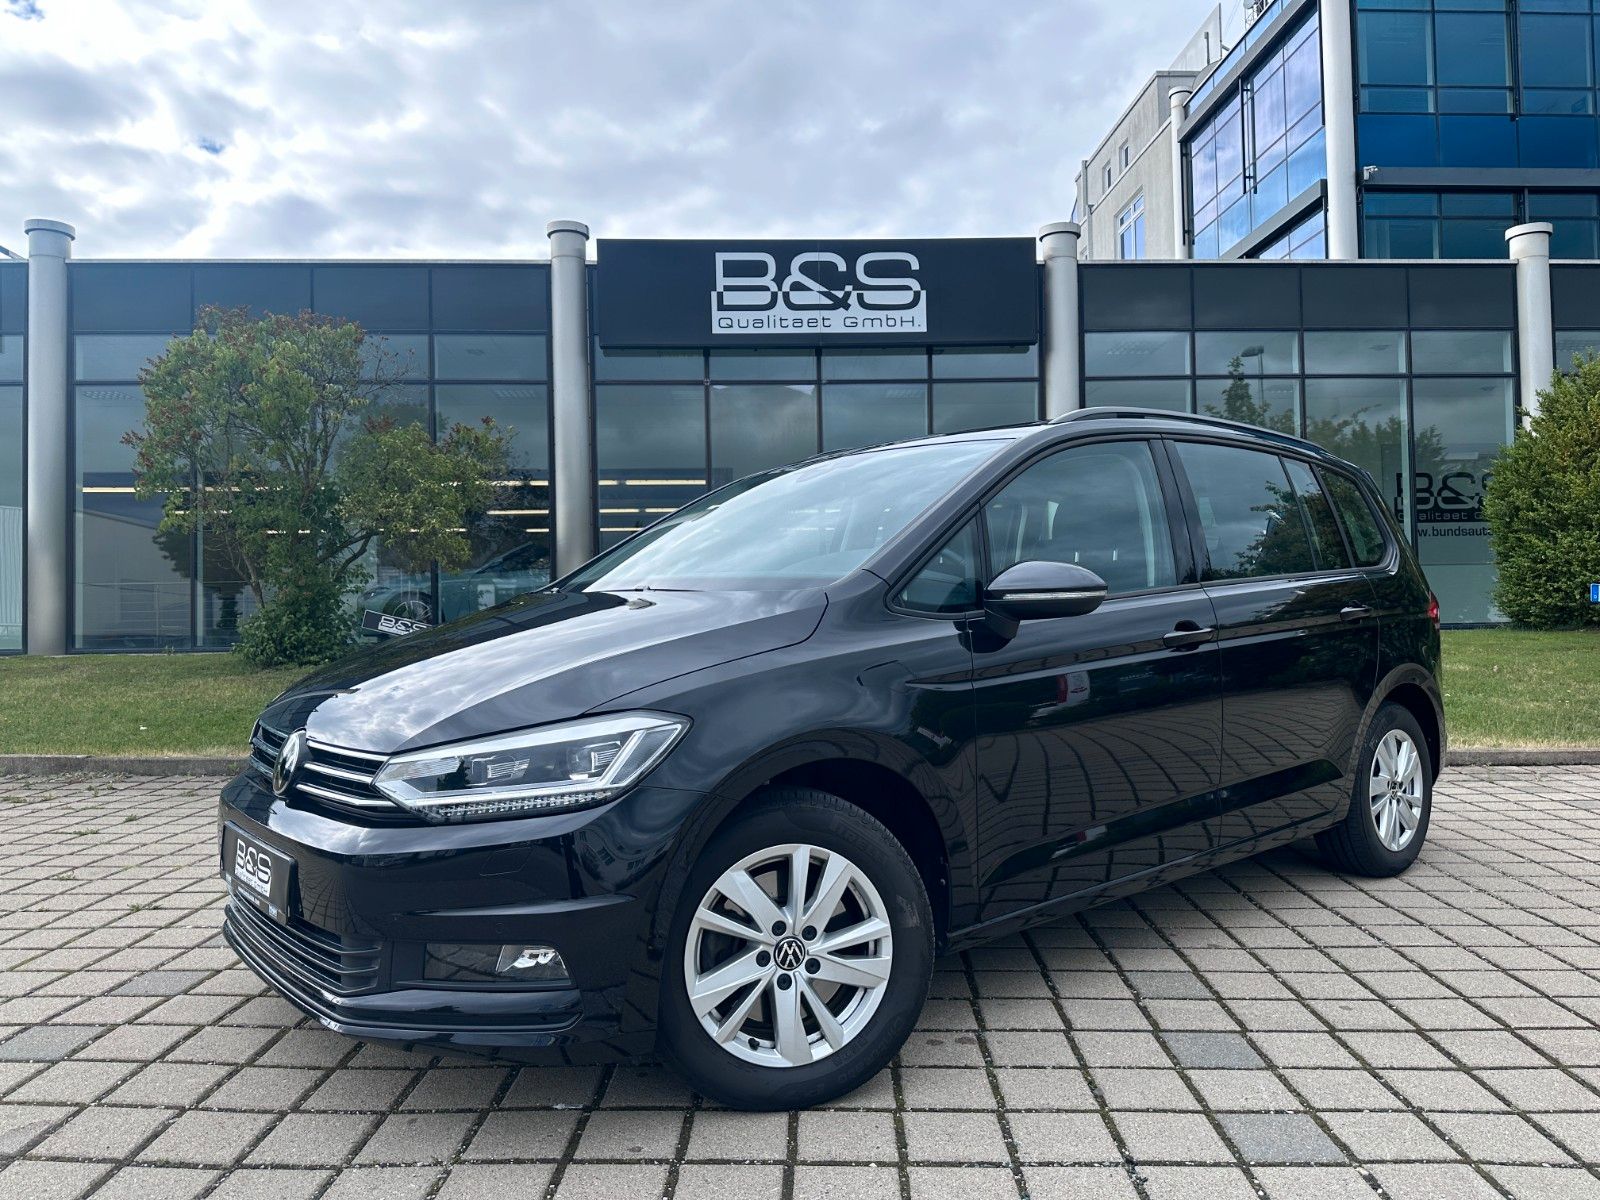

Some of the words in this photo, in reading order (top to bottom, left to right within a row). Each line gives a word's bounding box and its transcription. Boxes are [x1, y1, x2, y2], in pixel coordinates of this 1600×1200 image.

[715, 252, 921, 311] B&S
[718, 314, 832, 329] Qualitaet
[843, 314, 921, 328] GmbH.
[236, 838, 272, 884] B&S
